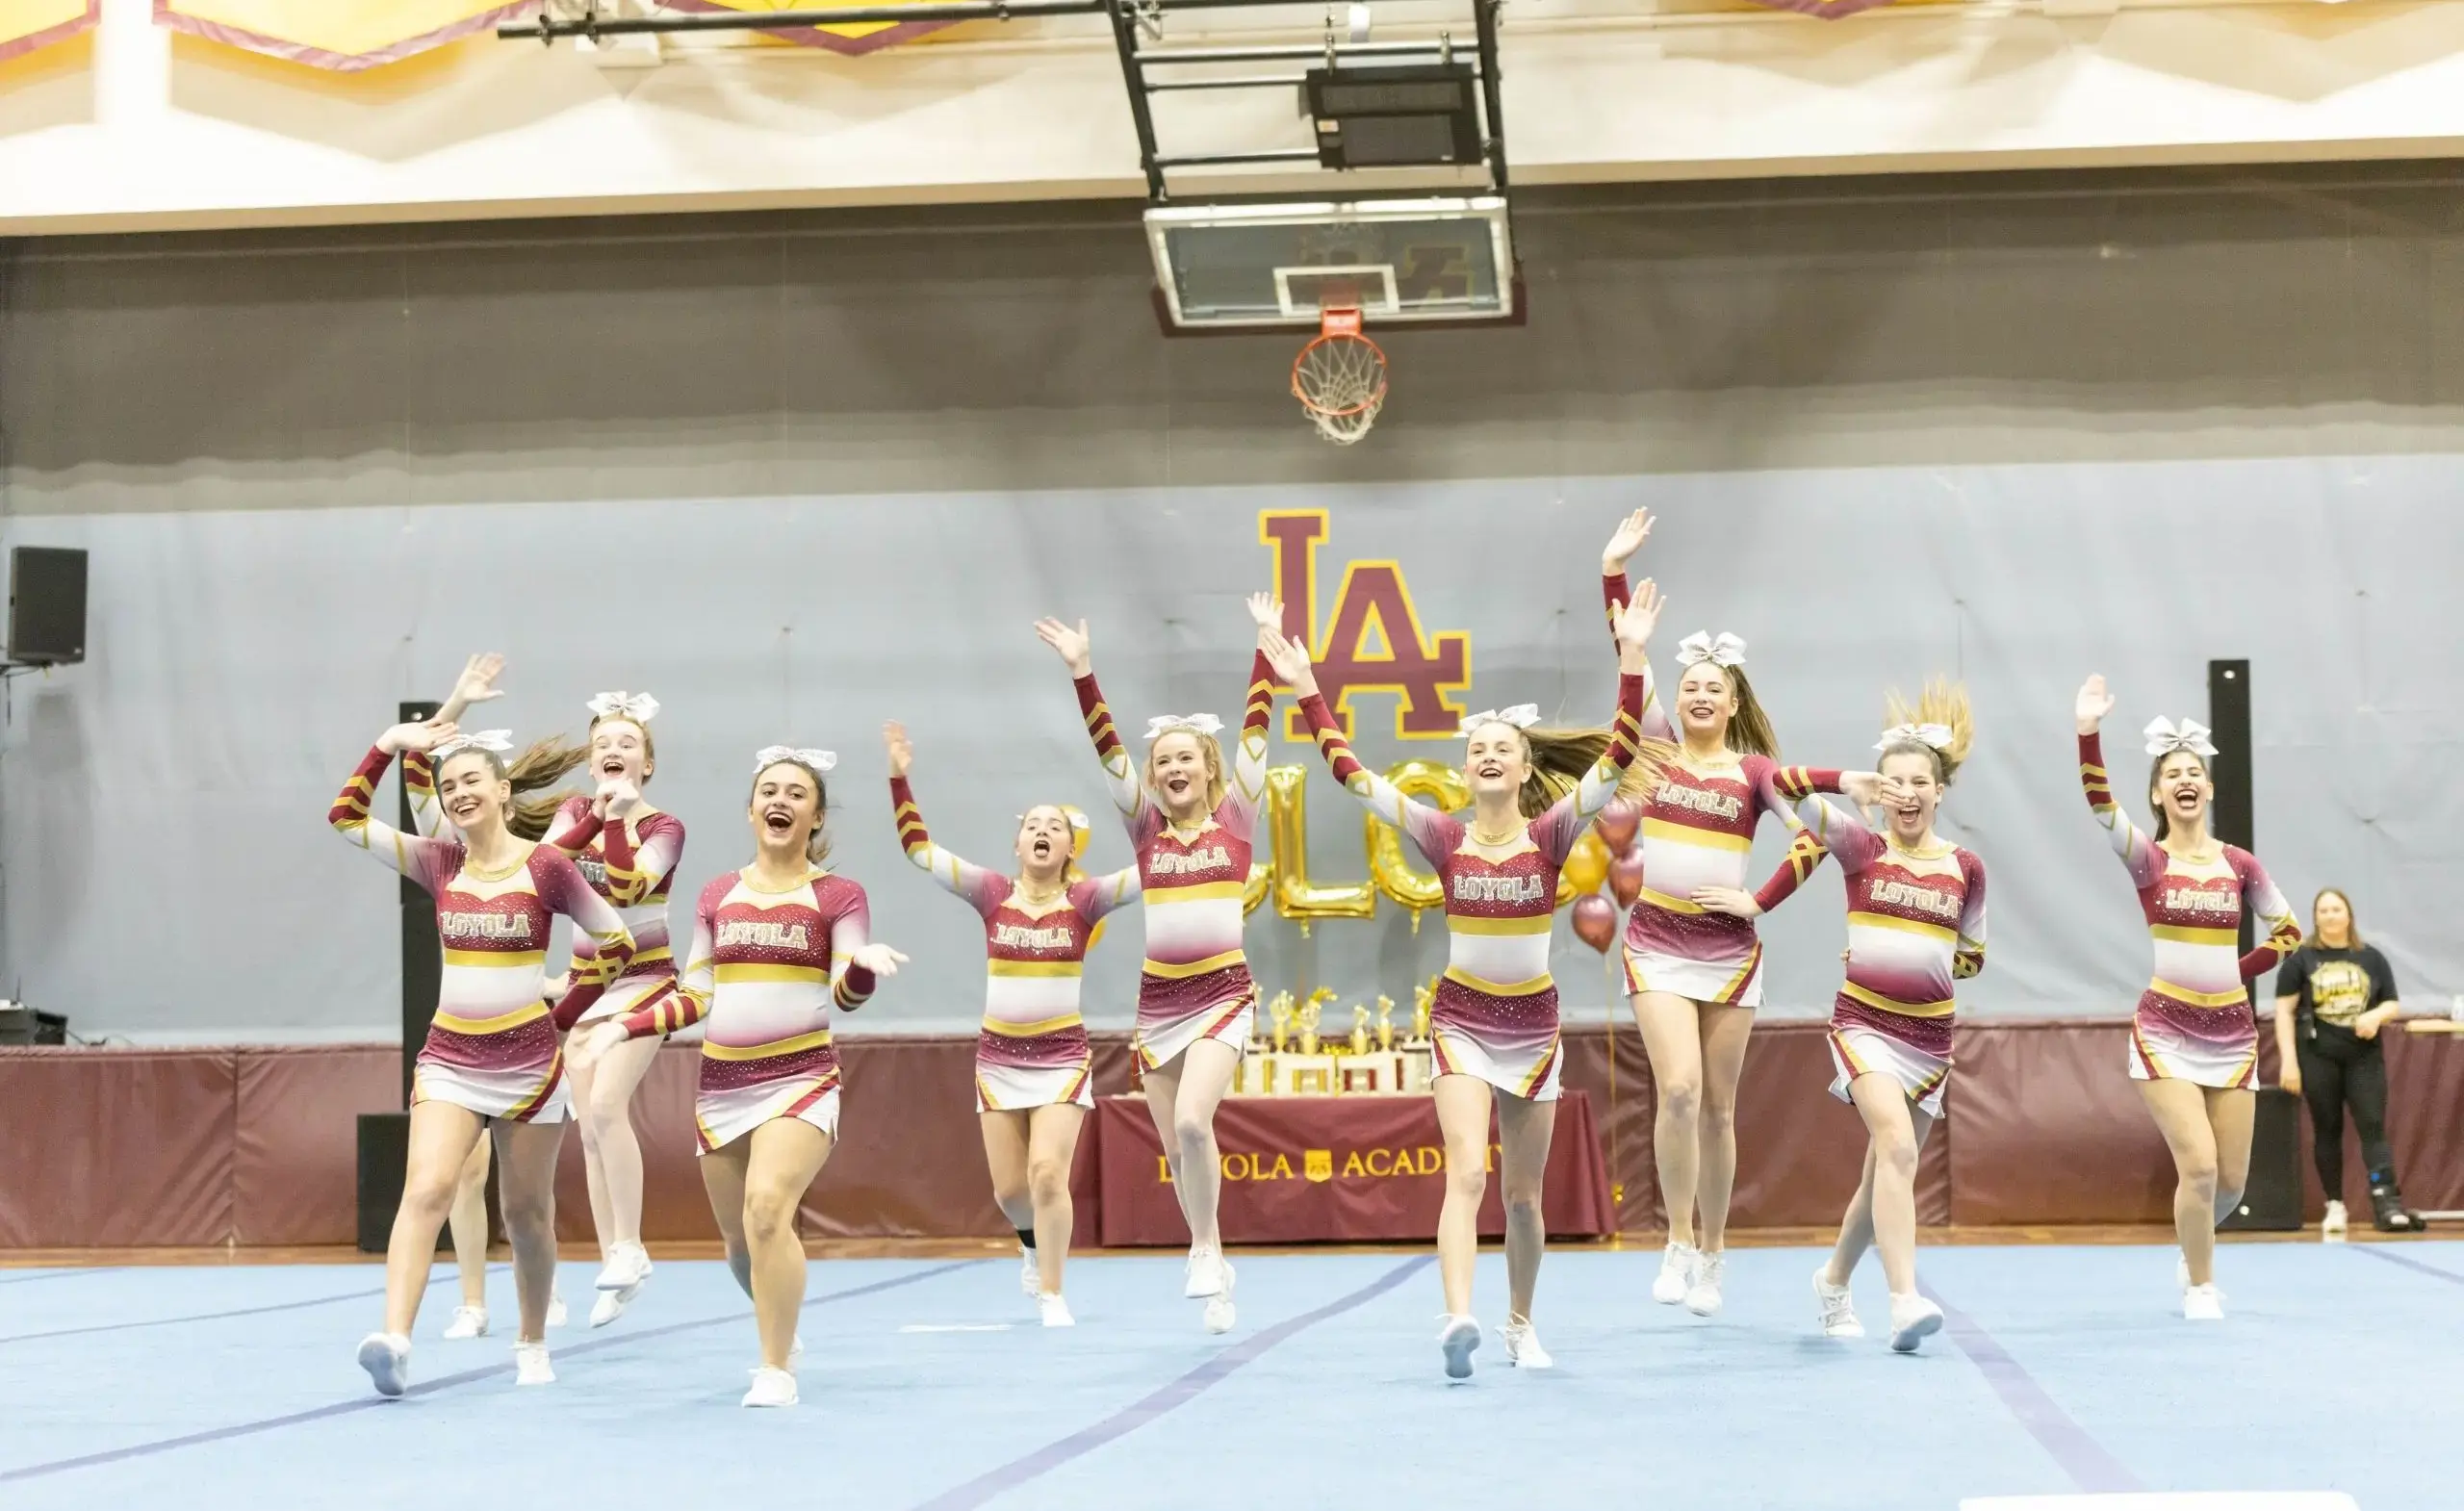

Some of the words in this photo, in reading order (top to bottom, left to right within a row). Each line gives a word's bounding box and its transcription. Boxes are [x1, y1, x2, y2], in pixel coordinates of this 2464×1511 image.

[1258, 508, 1472, 743] LA
[1656, 781, 1739, 819] LOYOLA
[1149, 846, 1232, 874] LOYOLA
[1453, 874, 1544, 901] LOYOLA
[1870, 879, 1959, 919] LOYOLA
[440, 910, 531, 937] LOYOLA
[715, 921, 808, 950] LOYOLA
[993, 924, 1073, 949] LOYOLA
[1158, 1153, 1295, 1183] LOLA
